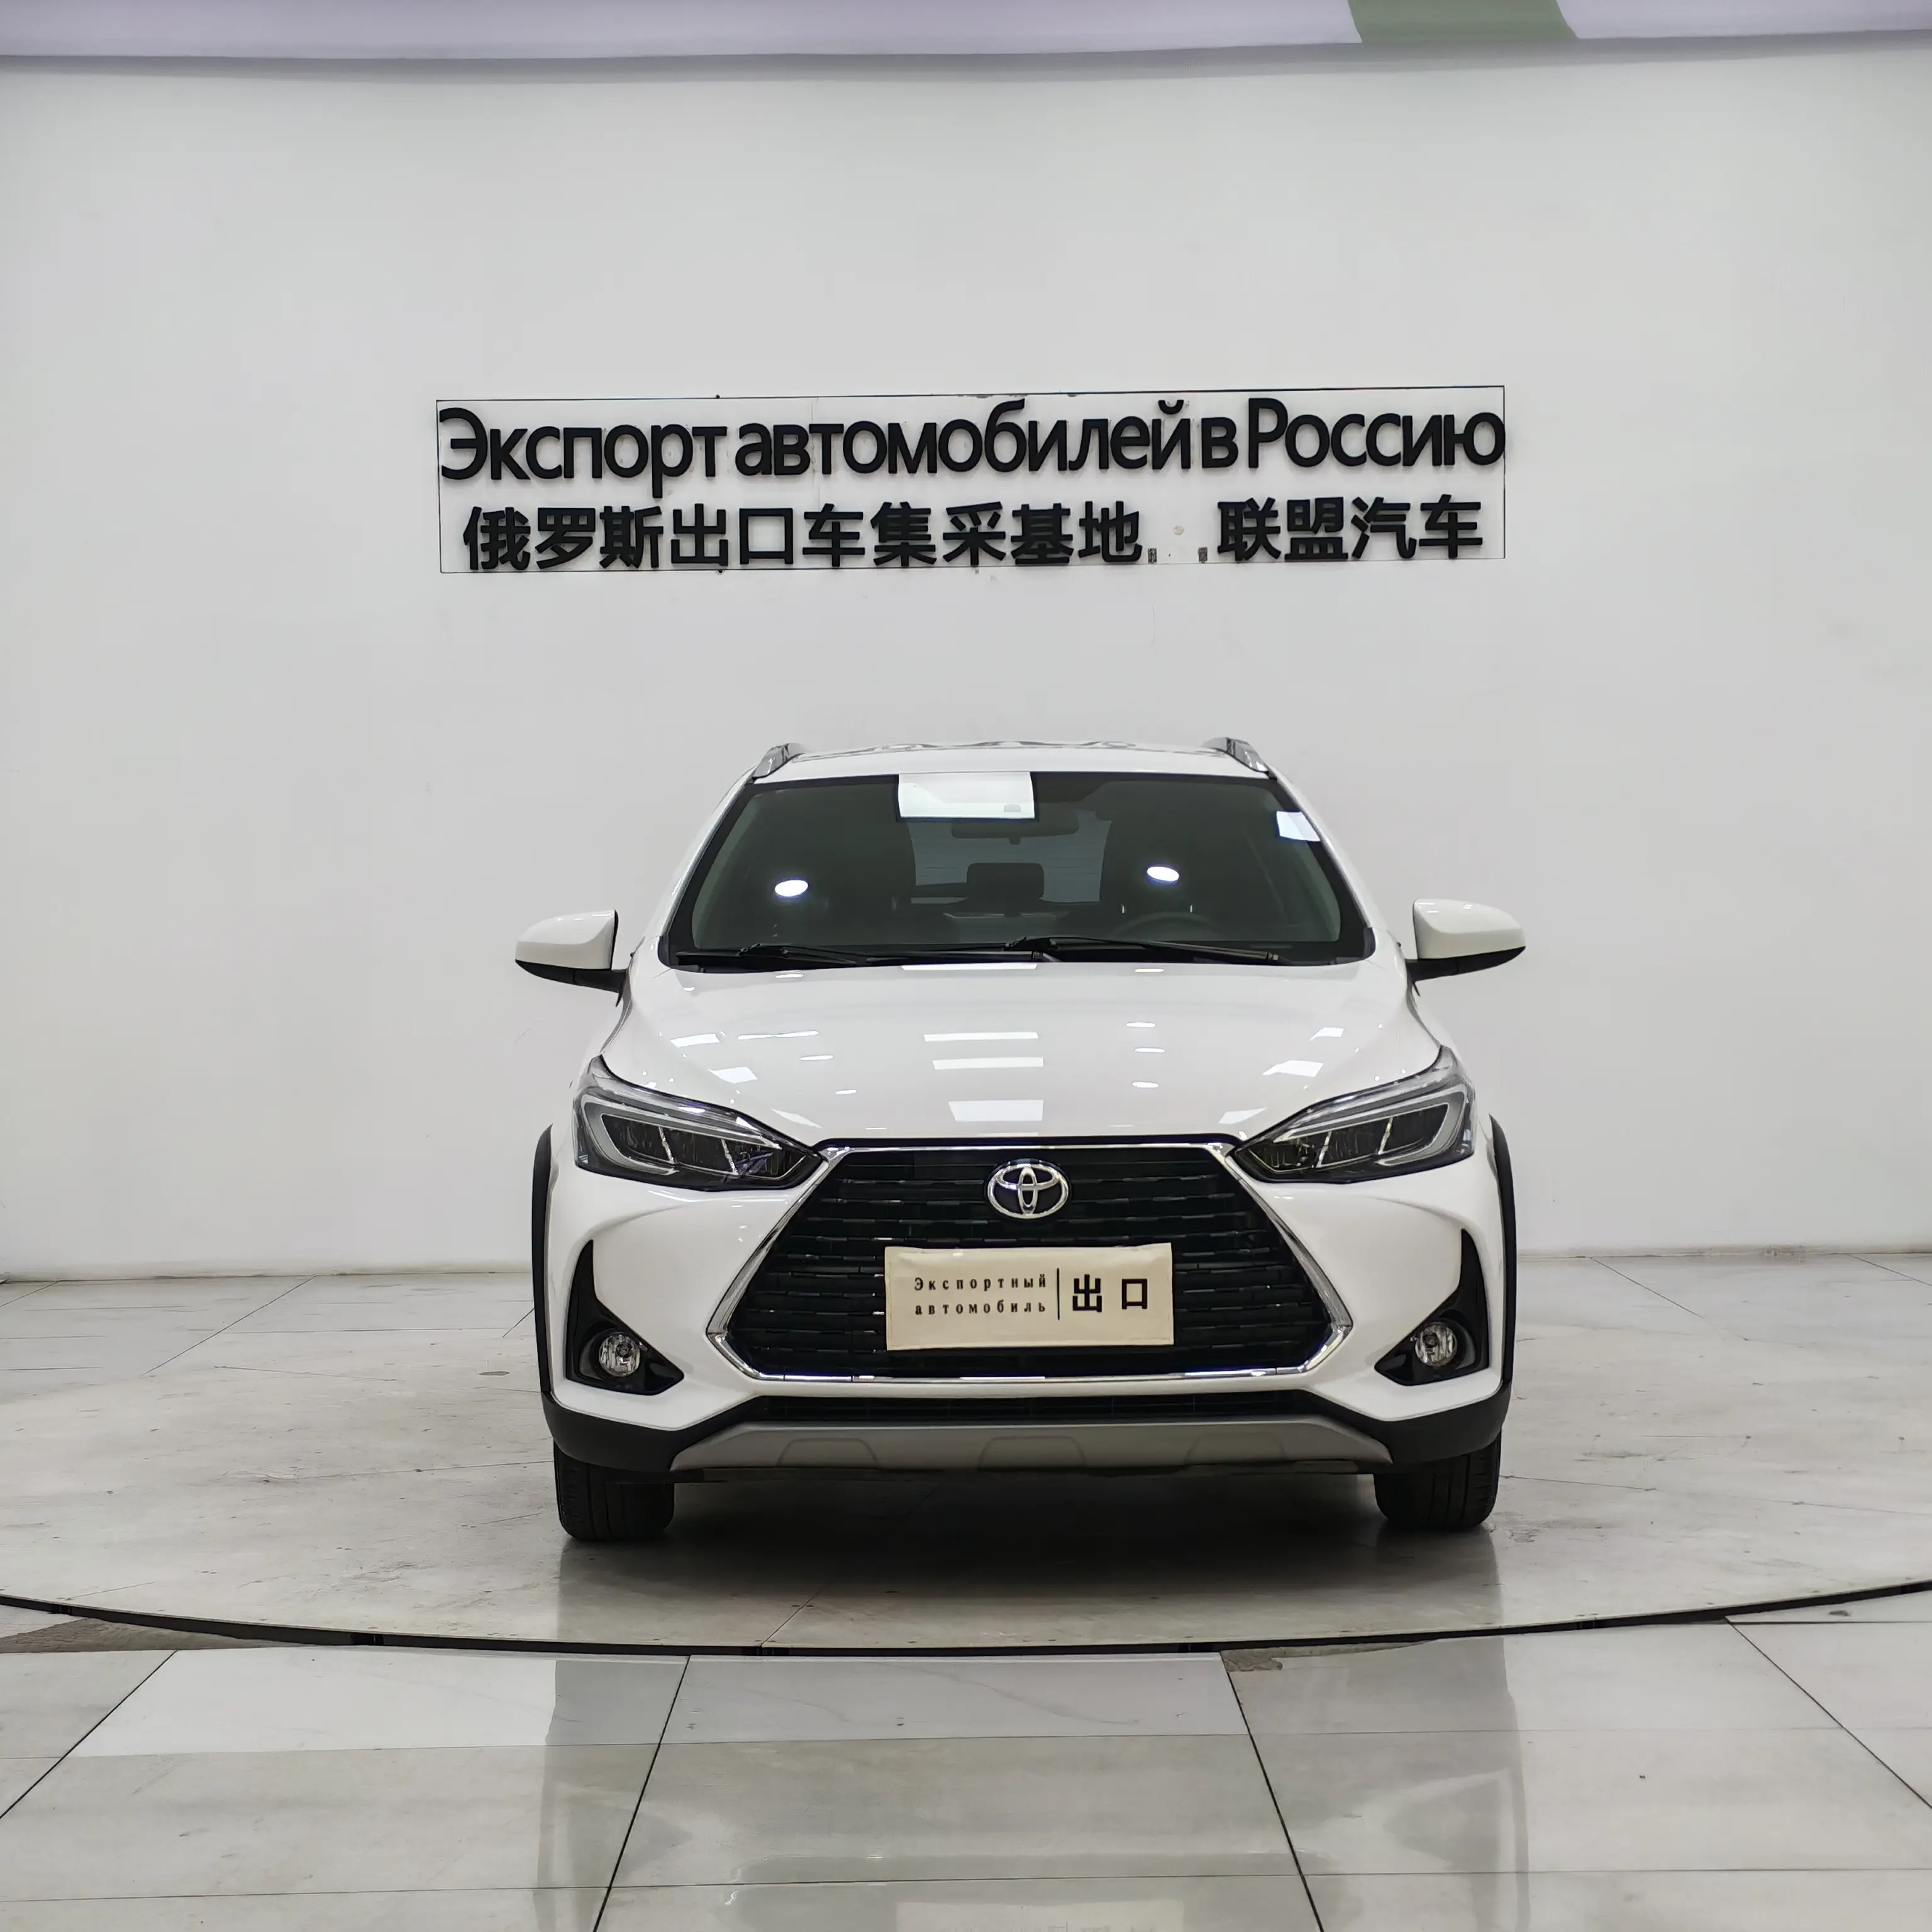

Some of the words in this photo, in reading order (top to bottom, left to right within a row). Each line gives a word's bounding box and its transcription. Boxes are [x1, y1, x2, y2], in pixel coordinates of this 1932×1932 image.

[439, 408, 728, 499] Экспорт
[735, 398, 1191, 477] автомобилей
[1201, 416, 1239, 469] в
[1248, 397, 1504, 469] Россию
[462, 500, 1143, 571] 俄罗斯出口车集采基地
[1216, 494, 1484, 562] 联盟汽车
[914, 1273, 1046, 1292] Экспортный
[1072, 1274, 1148, 1313] 出口
[914, 1299, 1046, 1316] автомобиль
